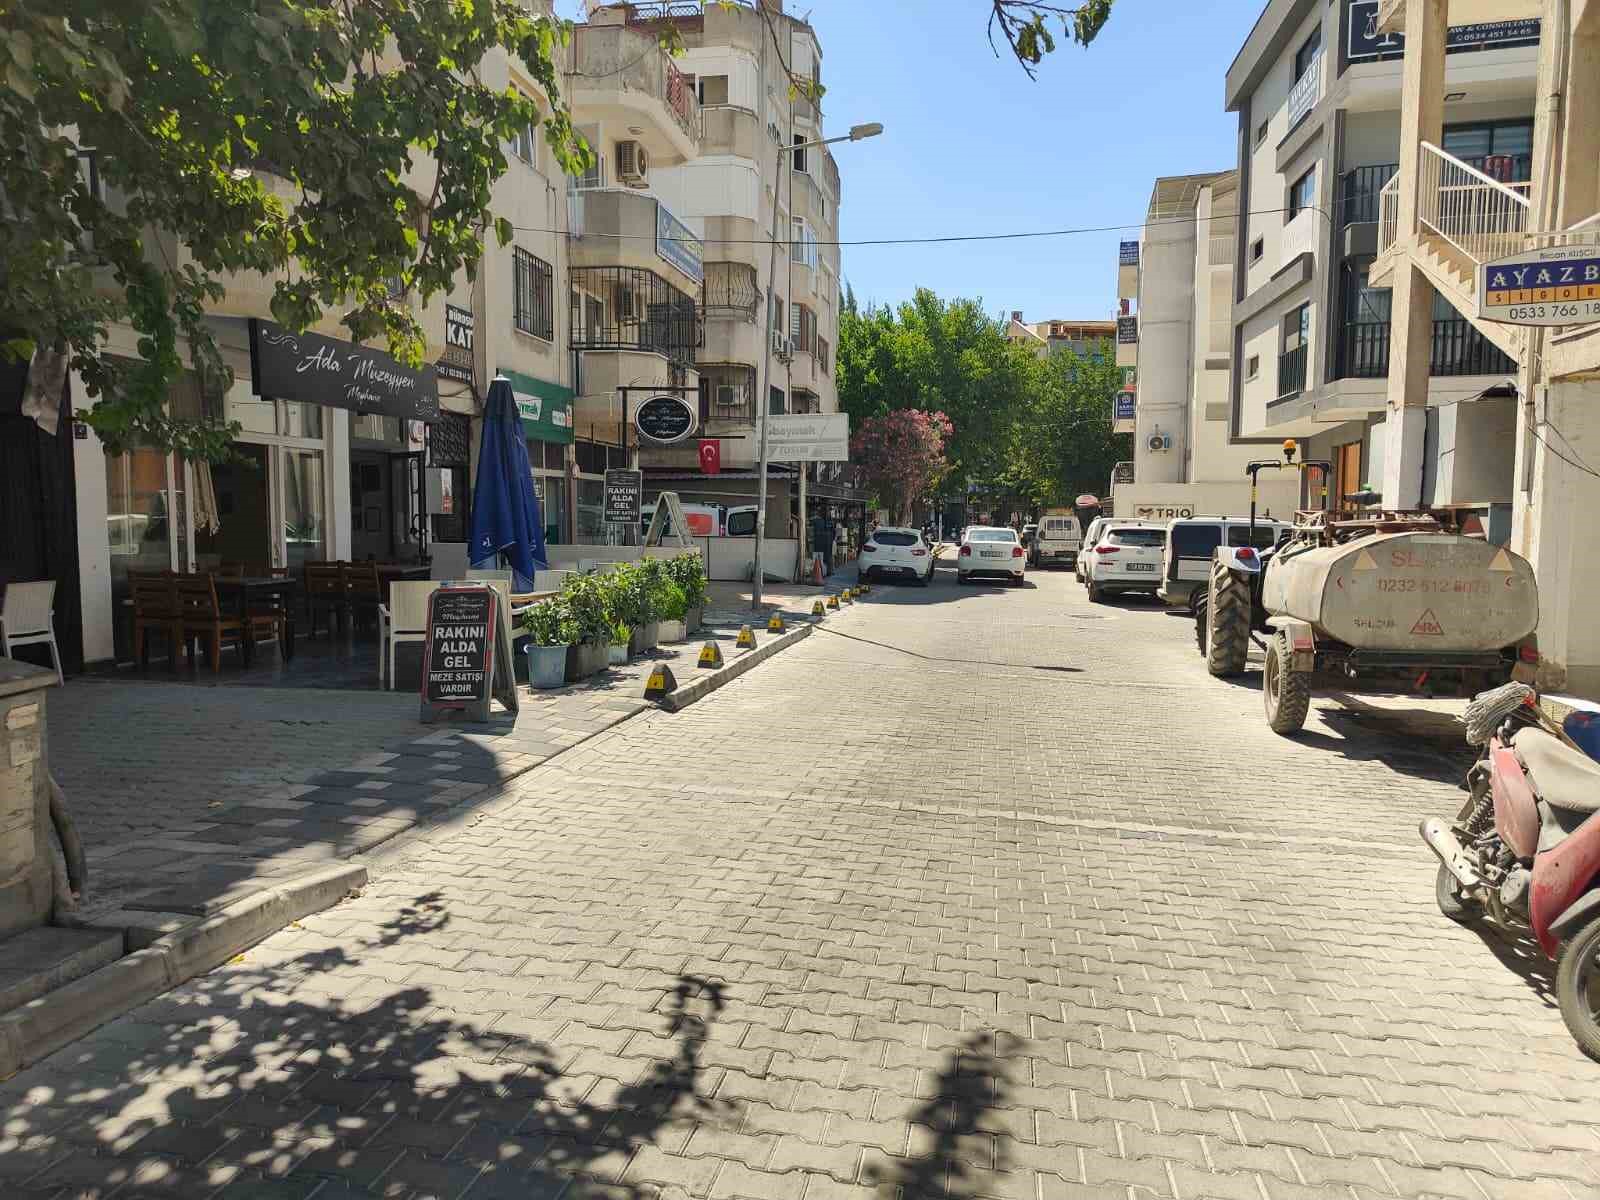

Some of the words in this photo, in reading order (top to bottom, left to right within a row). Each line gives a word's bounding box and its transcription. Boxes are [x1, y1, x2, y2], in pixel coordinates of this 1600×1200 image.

[1509, 307, 1545, 320] 0533
[1551, 305, 1578, 318] 766
[295, 344, 342, 373] Ada
[1155, 508, 1191, 519] TRIO
[439, 640, 477, 654] ALDA
[444, 656, 472, 668] GEL
[430, 672, 454, 682] MEZE
